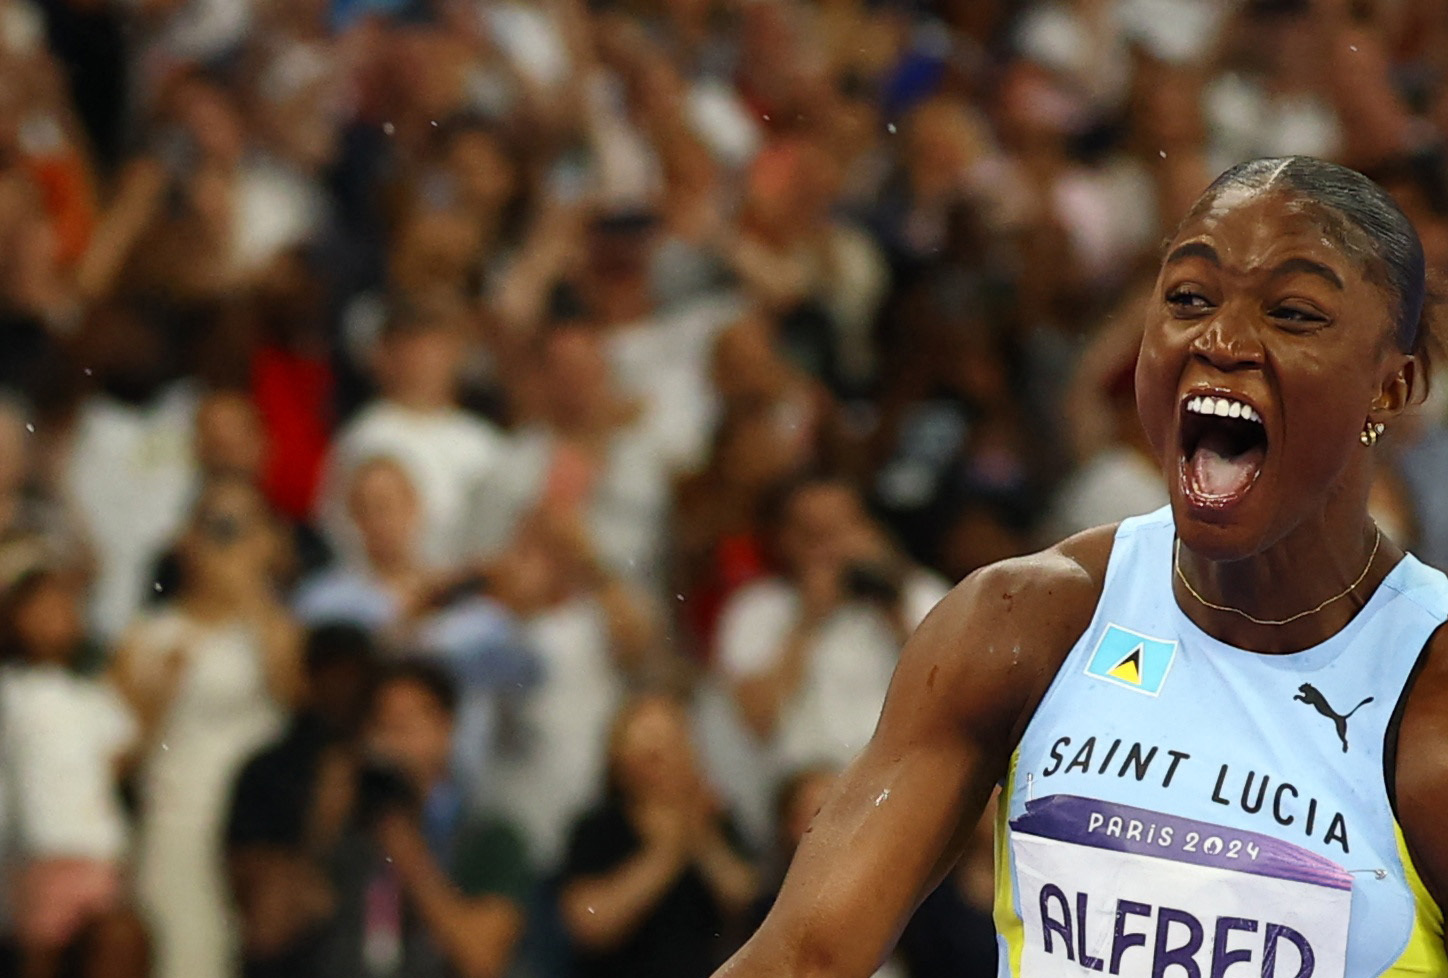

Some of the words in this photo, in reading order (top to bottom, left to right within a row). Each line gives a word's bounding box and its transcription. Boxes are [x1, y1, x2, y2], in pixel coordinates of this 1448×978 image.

[1042, 736, 1191, 788] SAINT
[1211, 763, 1350, 854] LUCIA
[1182, 832, 1260, 861] 2024
